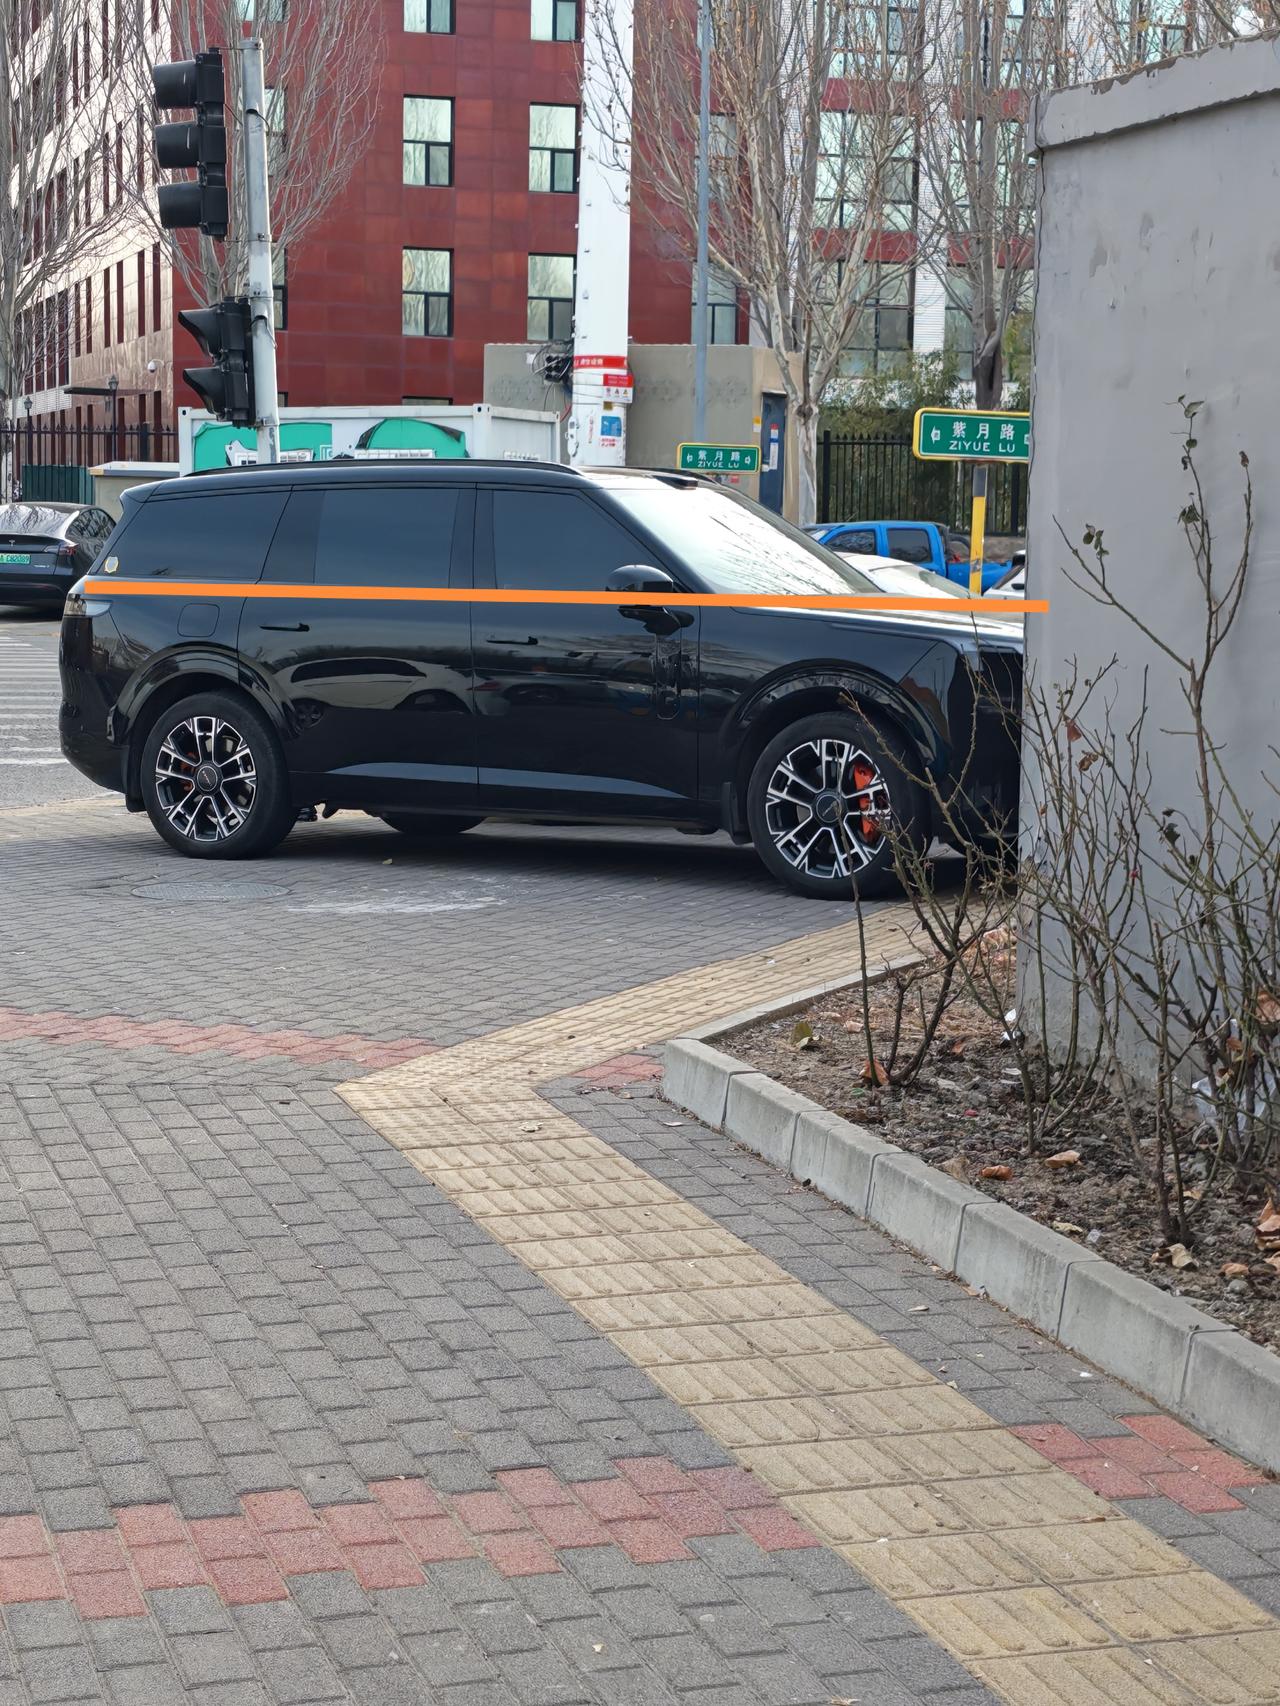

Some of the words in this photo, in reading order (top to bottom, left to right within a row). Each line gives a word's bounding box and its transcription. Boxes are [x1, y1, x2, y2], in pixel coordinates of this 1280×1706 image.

[952, 421, 1014, 440] 紫月路
[949, 440, 990, 452] ZIYUE
[998, 443, 1015, 453] LU
